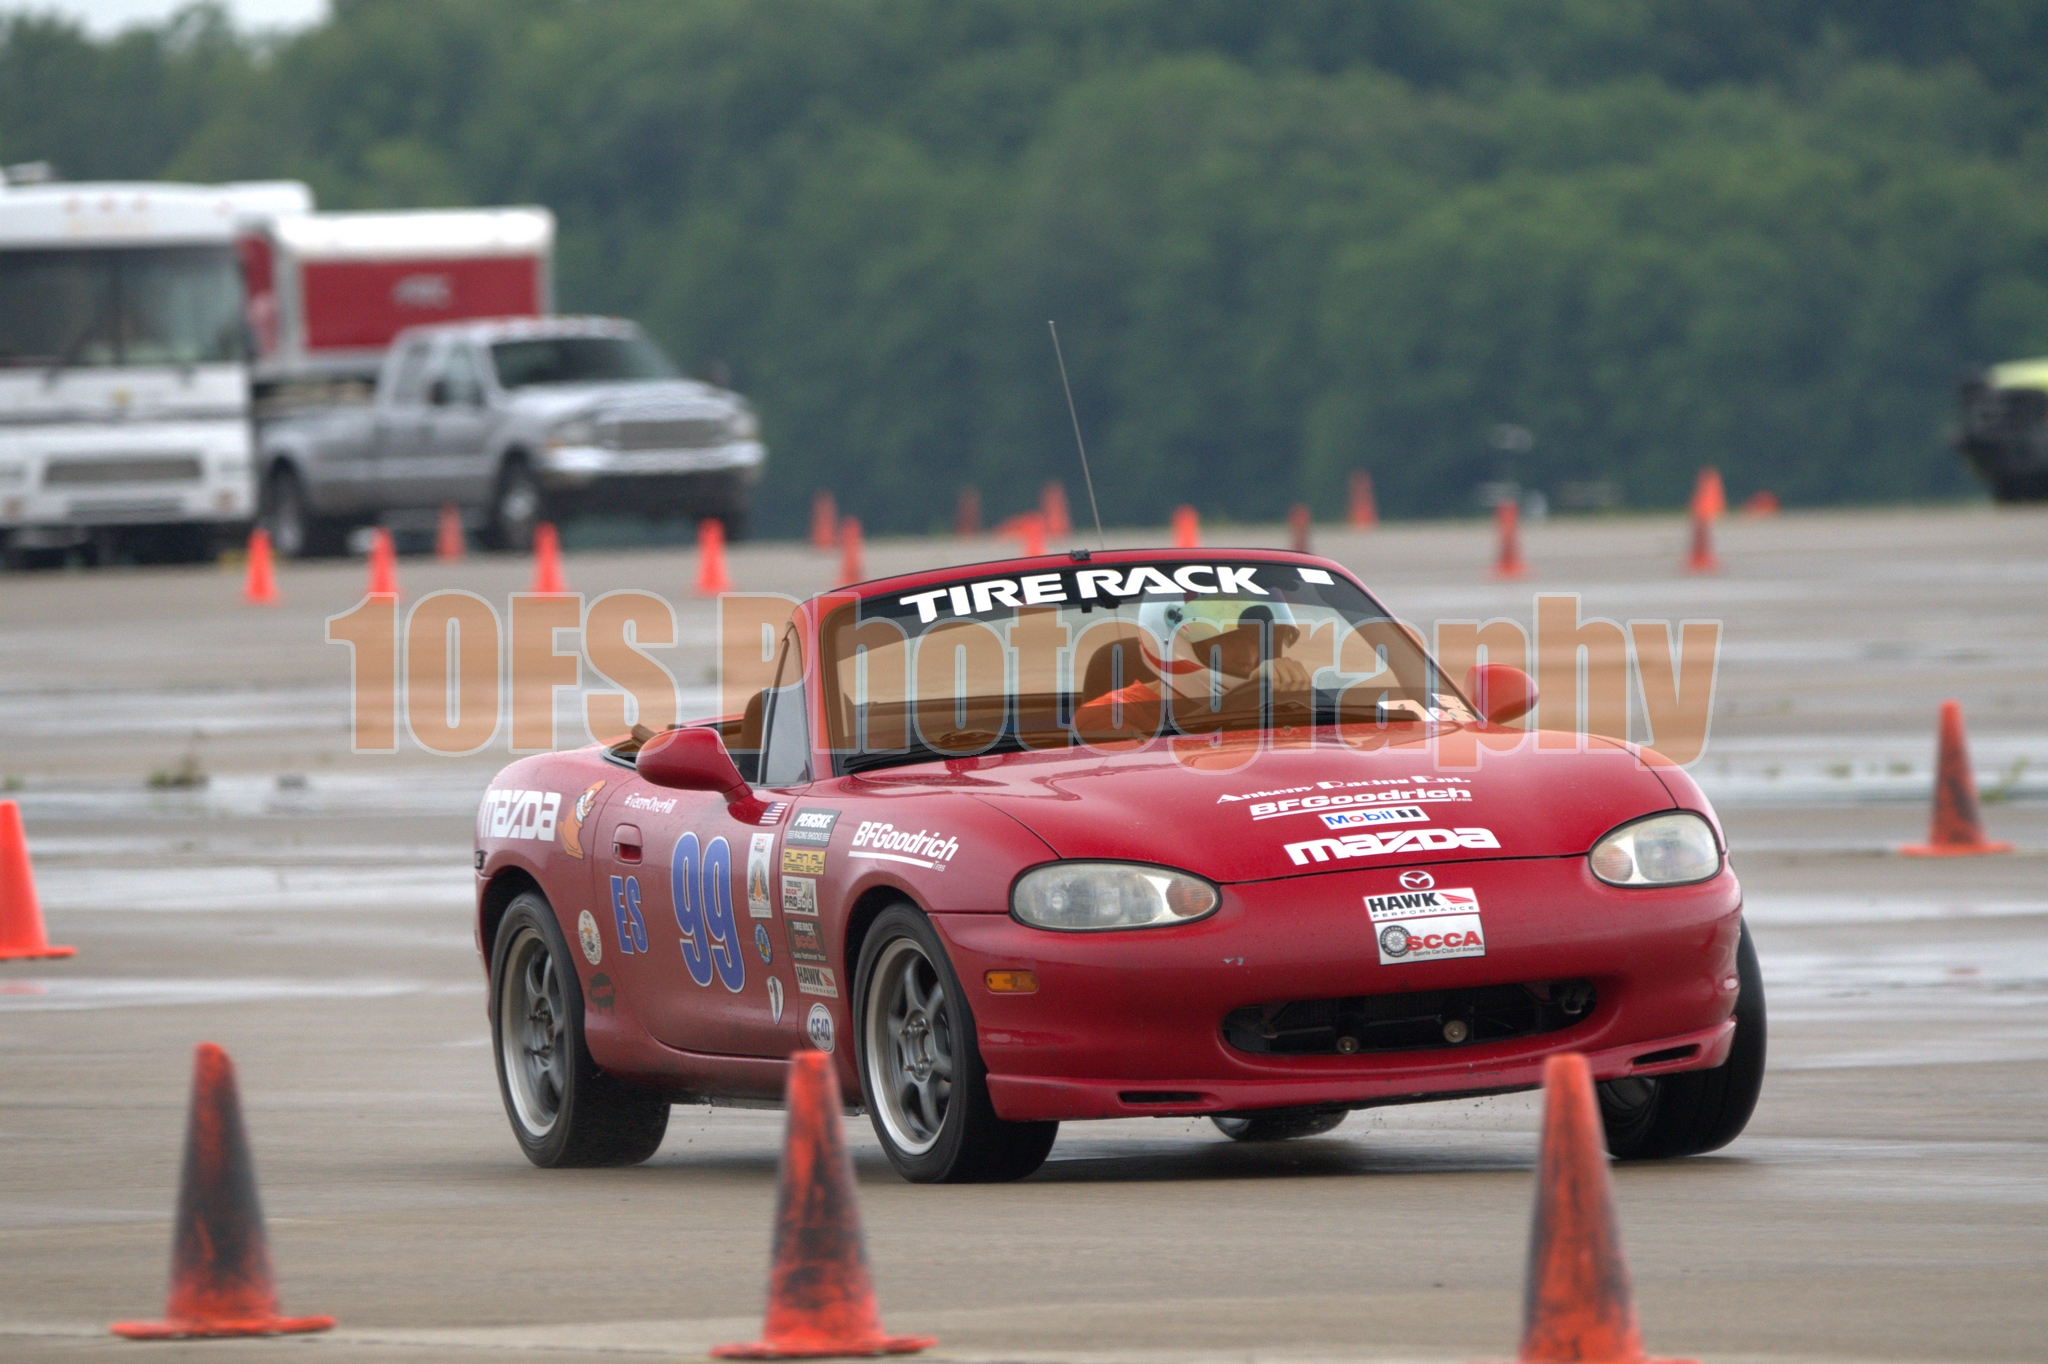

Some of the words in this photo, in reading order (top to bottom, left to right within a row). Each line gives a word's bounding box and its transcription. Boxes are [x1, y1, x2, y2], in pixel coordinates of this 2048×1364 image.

[899, 573, 1068, 624] TIRE
[1076, 565, 1270, 599] RACK
[1250, 788, 1472, 816] BFGoodrich
[794, 813, 835, 829] PENSKE
[1325, 810, 1395, 826] Mobil
[851, 821, 960, 862] BFGoodrich
[1368, 892, 1441, 912] HAWK
[1373, 905, 1475, 919] PERFORMANCE
[610, 875, 648, 955] ES
[671, 831, 746, 994] 99
[794, 934, 820, 950] SCCA
[1405, 931, 1483, 951] SCCA
[1413, 948, 1431, 957] Sports
[1432, 947, 1442, 955] Car
[1442, 946, 1455, 954] Club
[796, 966, 823, 987] HAWK
[800, 985, 837, 995] PERFORMANCE
